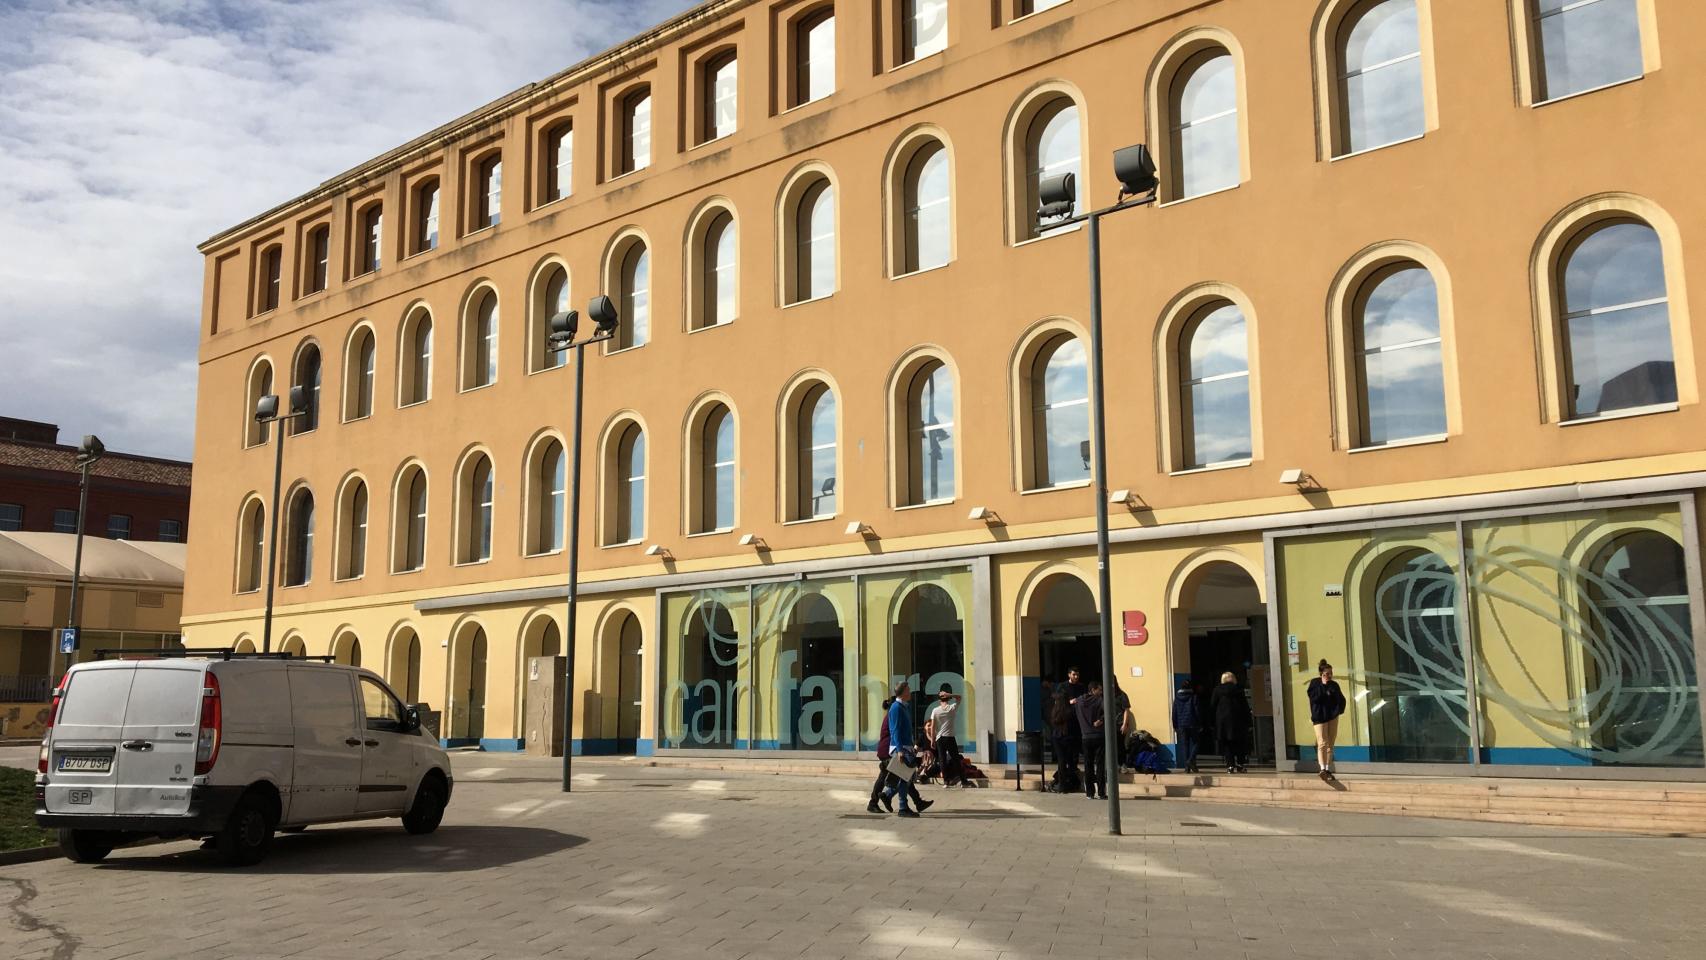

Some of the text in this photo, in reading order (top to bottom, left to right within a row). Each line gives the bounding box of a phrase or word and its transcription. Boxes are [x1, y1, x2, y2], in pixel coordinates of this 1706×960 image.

[1122, 610, 1149, 646] B
[65, 632, 71, 642] P
[663, 678, 755, 746] can
[65, 757, 89, 768] 8707
[71, 791, 89, 802] SP
